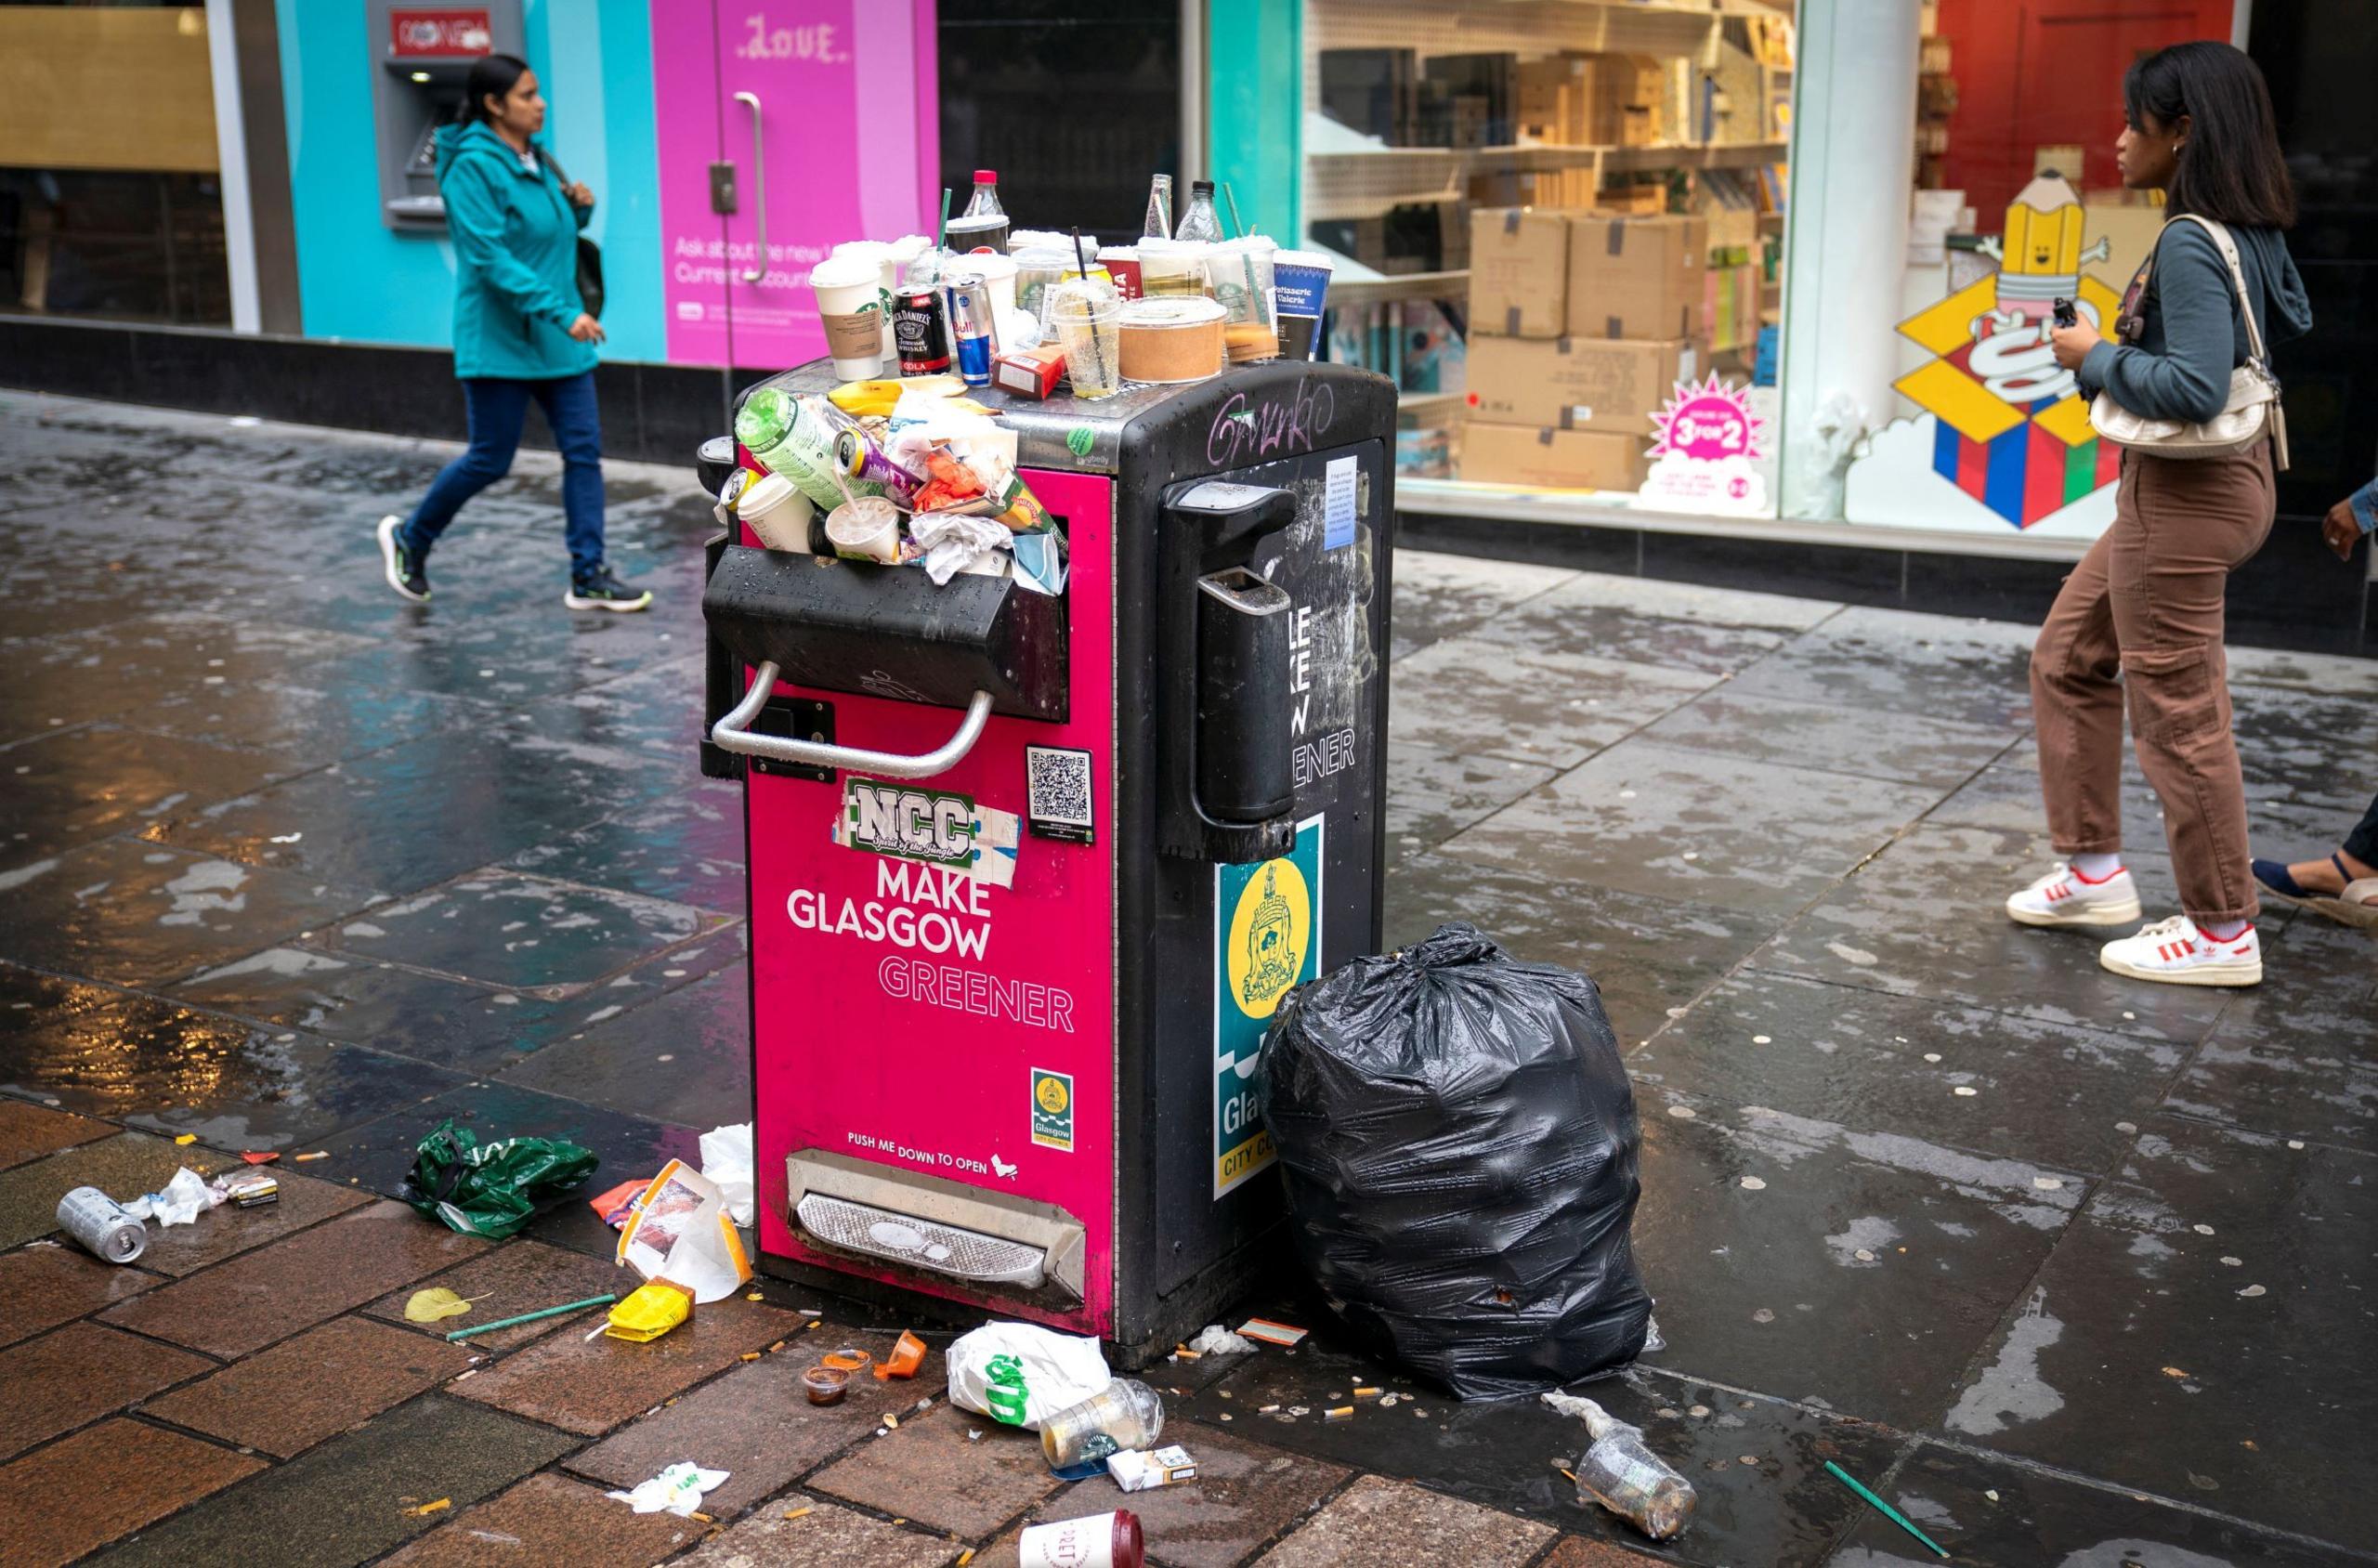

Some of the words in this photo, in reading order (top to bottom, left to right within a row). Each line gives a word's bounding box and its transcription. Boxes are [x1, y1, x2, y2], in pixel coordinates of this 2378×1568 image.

[1293, 728, 1355, 789] ENER
[855, 785, 970, 858] NCC
[873, 833, 897, 851] Spirit
[897, 841, 910, 855] of
[910, 841, 923, 853] the
[923, 843, 955, 861] Jungle
[877, 859, 991, 918] MAKE
[787, 889, 991, 961] GLASGOW
[878, 955, 1075, 1033] GREENER
[848, 1132, 875, 1148] PUSH
[878, 1139, 895, 1153] ME
[898, 1146, 934, 1165] DOWN
[937, 1153, 953, 1166] TO
[956, 1157, 987, 1174] OPEN
[1035, 1122, 1069, 1139] Glasgow
[1224, 1146, 1252, 1177] CITY
